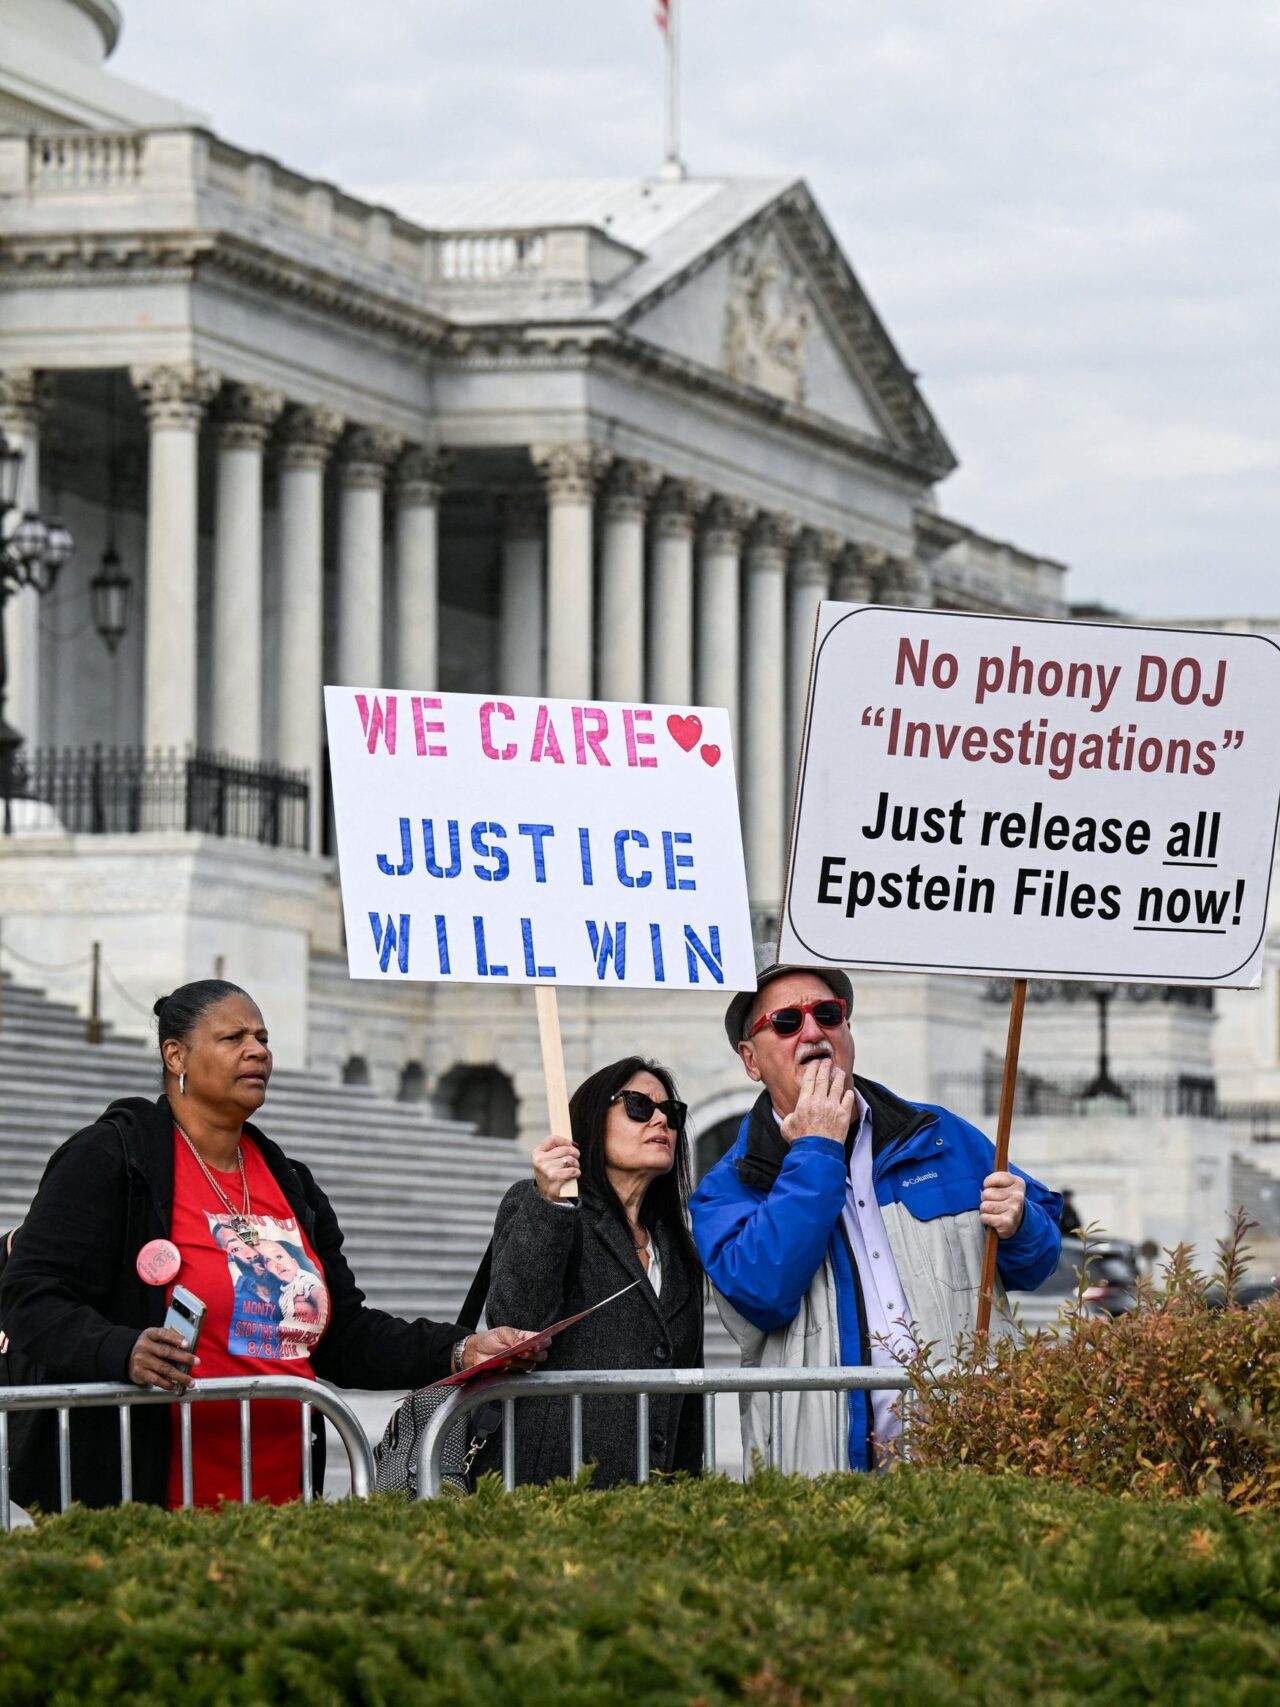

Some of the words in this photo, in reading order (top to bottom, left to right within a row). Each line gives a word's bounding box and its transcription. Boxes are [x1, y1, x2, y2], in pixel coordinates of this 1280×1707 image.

[896, 637, 959, 690] No
[975, 646, 1122, 714] phony
[1136, 654, 1228, 708] DOJ
[354, 694, 449, 758] WE
[478, 701, 660, 769] CARE
[860, 704, 1246, 781] “Investigations”
[375, 816, 698, 892] JUSTICE
[861, 791, 967, 846] Just
[980, 801, 1152, 857] release
[1166, 811, 1222, 859] all
[816, 856, 997, 919] Epstein
[1013, 868, 1123, 922] Files
[1137, 879, 1247, 927] now!
[367, 911, 558, 979] WILL
[584, 919, 725, 985] WIN
[908, 1171, 938, 1184] Columbia
[234, 1319, 257, 1339] STOP
[257, 1322, 274, 1341] THE
[241, 1300, 277, 1321] MONTY
[247, 1340, 300, 1358] 8/8/2018
